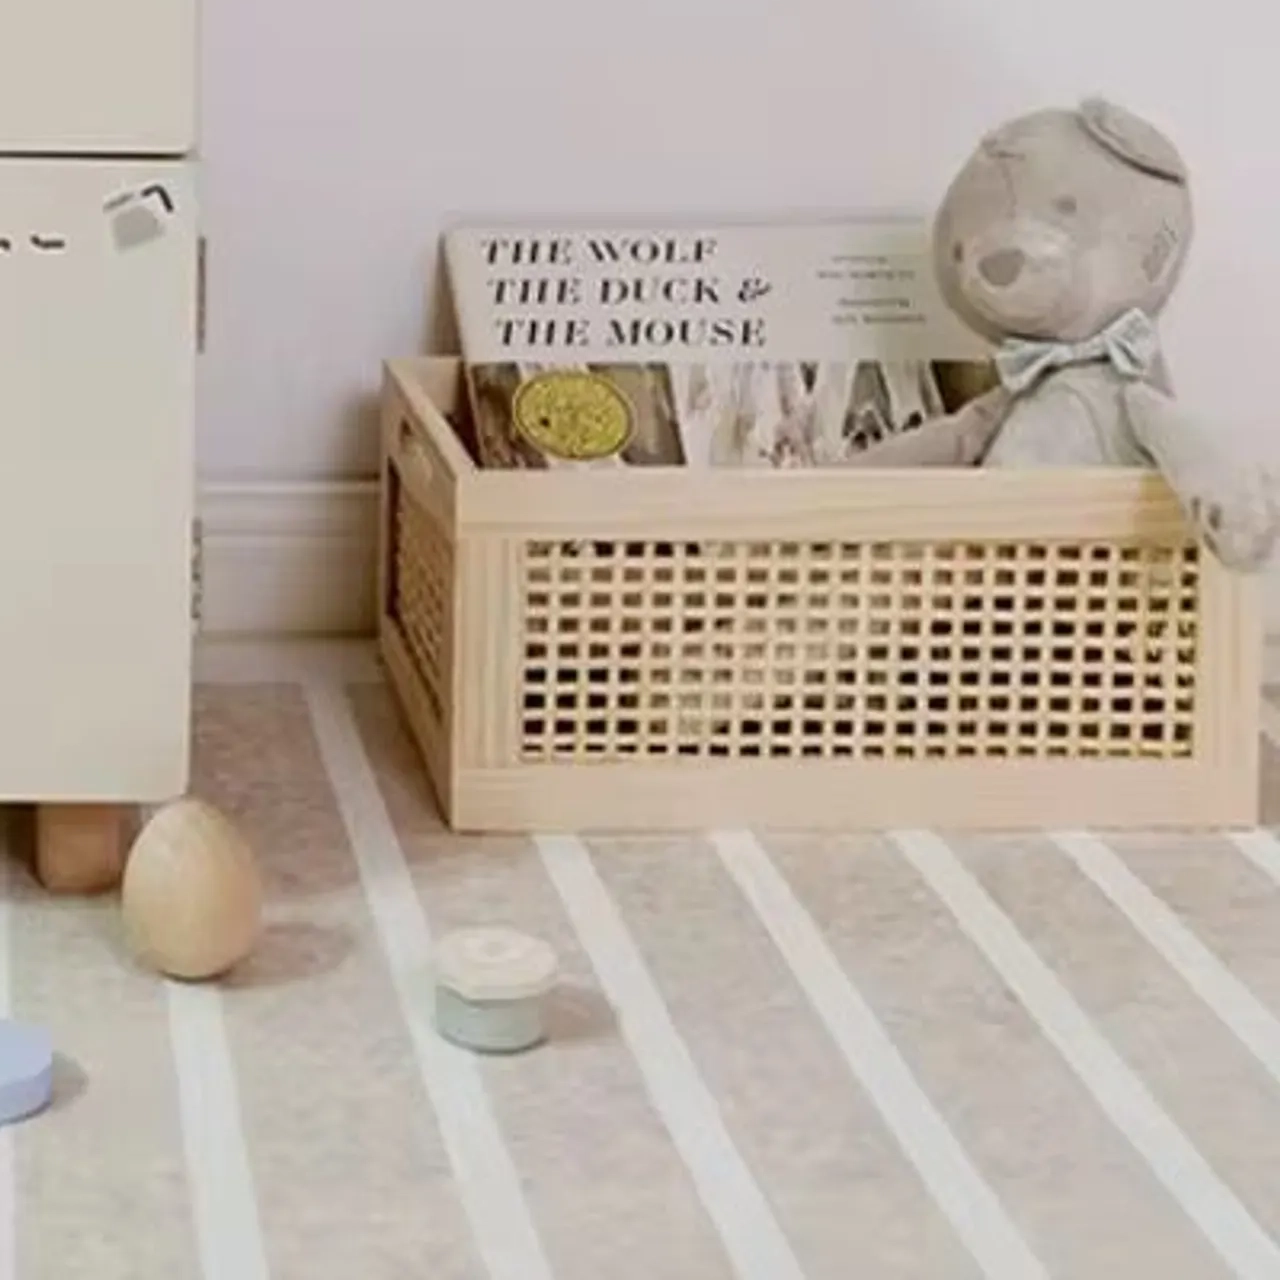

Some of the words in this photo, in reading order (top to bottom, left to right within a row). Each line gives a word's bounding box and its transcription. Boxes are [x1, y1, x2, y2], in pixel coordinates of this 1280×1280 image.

[481, 239, 571, 263] THE
[588, 239, 718, 263] WOLF
[487, 278, 581, 304] THE
[600, 278, 720, 304] DUCK
[737, 277, 771, 302] &
[496, 320, 590, 346] THE
[606, 319, 767, 346] MOUSE
